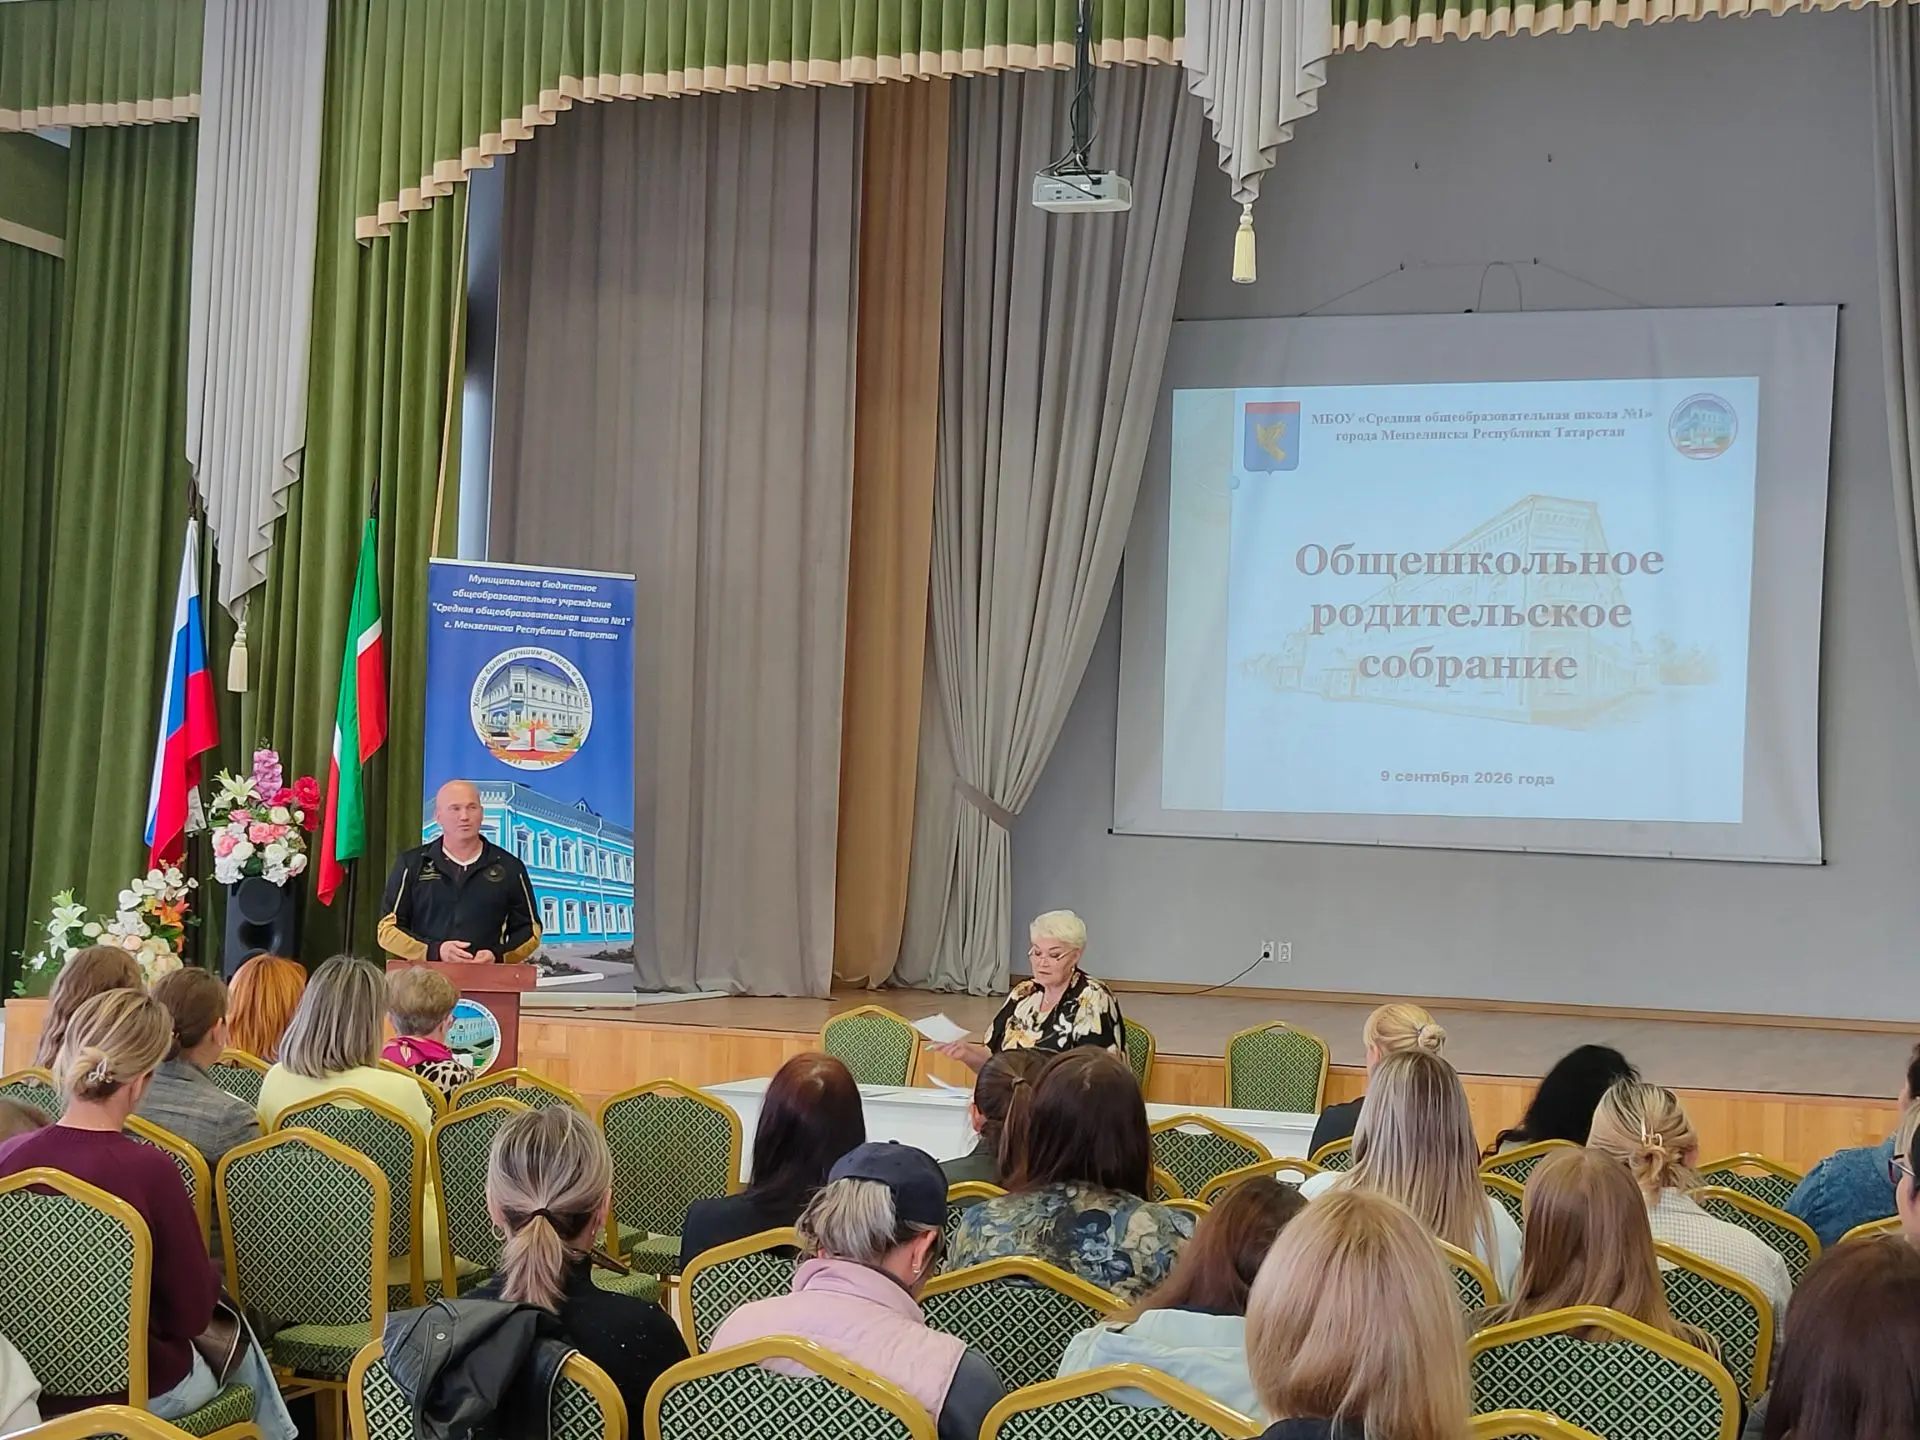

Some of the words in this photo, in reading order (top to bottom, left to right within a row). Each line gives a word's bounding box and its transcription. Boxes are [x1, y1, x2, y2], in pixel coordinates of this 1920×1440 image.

[1311, 412, 1356, 425] МБОУ
[1358, 412, 1421, 427] «Средняя
[1424, 410, 1570, 425] общеобразовательная
[1574, 410, 1618, 421] школа
[1621, 408, 1653, 420] №1»
[1335, 431, 1378, 444] города
[1381, 429, 1468, 442] Мензелинска
[1472, 427, 1551, 442] Республики
[1554, 426, 1626, 441] Татарстан
[1294, 542, 1665, 580] Общешкольное
[467, 573, 541, 588] Муниципальное
[541, 580, 598, 593] бюджетное
[452, 588, 558, 605] общеобразовательное
[558, 598, 612, 609] учреждение
[432, 602, 474, 614] "Средняя
[475, 606, 580, 622] общеобразовательная
[580, 615, 609, 625] школа
[1309, 602, 1633, 635] родительское
[454, 620, 514, 632] Мензелинска
[515, 624, 567, 637] Республики
[568, 628, 619, 641] Татарстан
[1358, 645, 1579, 688] собрание
[1380, 770, 1391, 782] 9
[1395, 771, 1470, 786] сентября
[1474, 772, 1513, 784] 2026
[1518, 775, 1556, 787] года
